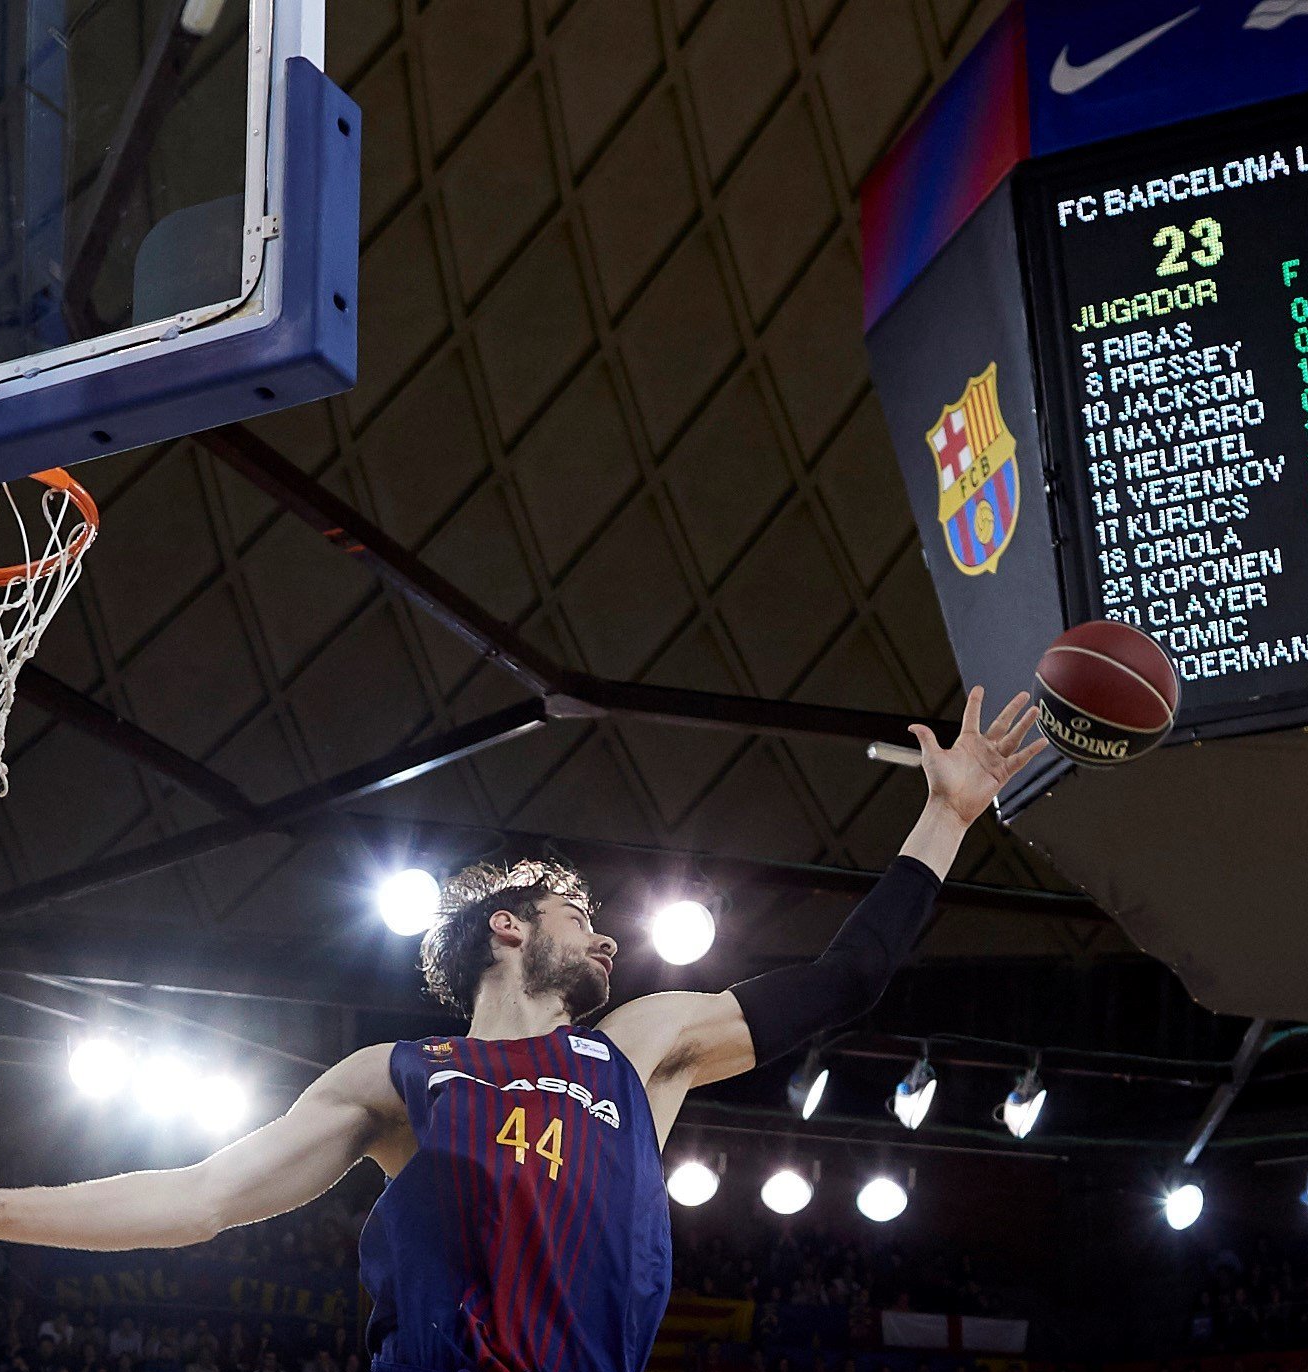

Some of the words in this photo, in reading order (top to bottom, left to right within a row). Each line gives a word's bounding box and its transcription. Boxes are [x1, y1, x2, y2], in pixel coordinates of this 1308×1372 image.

[1058, 196, 1097, 227] FC
[1104, 151, 1290, 216] BARCELONA
[1153, 217, 1224, 276] 23
[1072, 278, 1218, 332] JUGADOR
[1282, 259, 1299, 286] F
[1081, 342, 1096, 368] 5
[1102, 321, 1192, 364] RIBAS
[1110, 340, 1242, 393] PRESSEY
[1082, 401, 1111, 428] 10
[1118, 369, 1254, 422] JACKSON
[1084, 430, 1107, 458] 11
[1113, 399, 1265, 453] NAVARRO
[1089, 460, 1117, 487] 13
[1123, 433, 1254, 480] HEURTEL
[1092, 489, 1121, 517] 14
[1127, 455, 1285, 509] VEZENKOV
[1095, 519, 1119, 545] 17
[1127, 493, 1250, 540] KURUCS
[1098, 548, 1127, 575] 18
[1133, 527, 1243, 569] ORIOLA
[1102, 576, 1134, 605] 25
[1141, 547, 1282, 598] KOPONEN
[1148, 582, 1267, 626] CLAVER
[496, 1106, 563, 1181] 44
